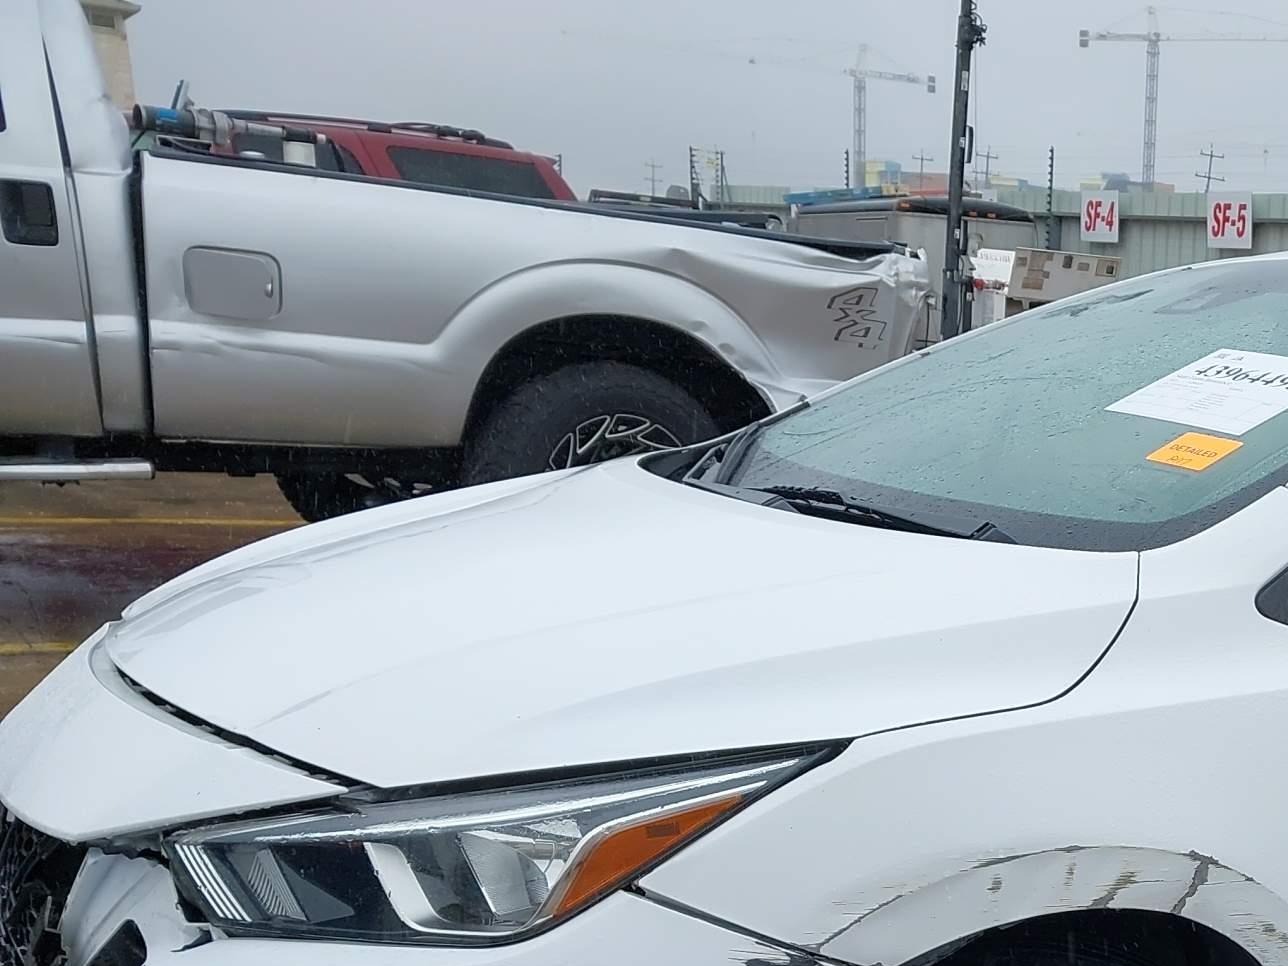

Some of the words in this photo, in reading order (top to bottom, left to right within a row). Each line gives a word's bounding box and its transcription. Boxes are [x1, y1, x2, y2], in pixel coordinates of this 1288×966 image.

[1084, 200, 1115, 233] SF-4
[1211, 202, 1247, 239] SF-5
[1169, 443, 1219, 459] DETAILED
